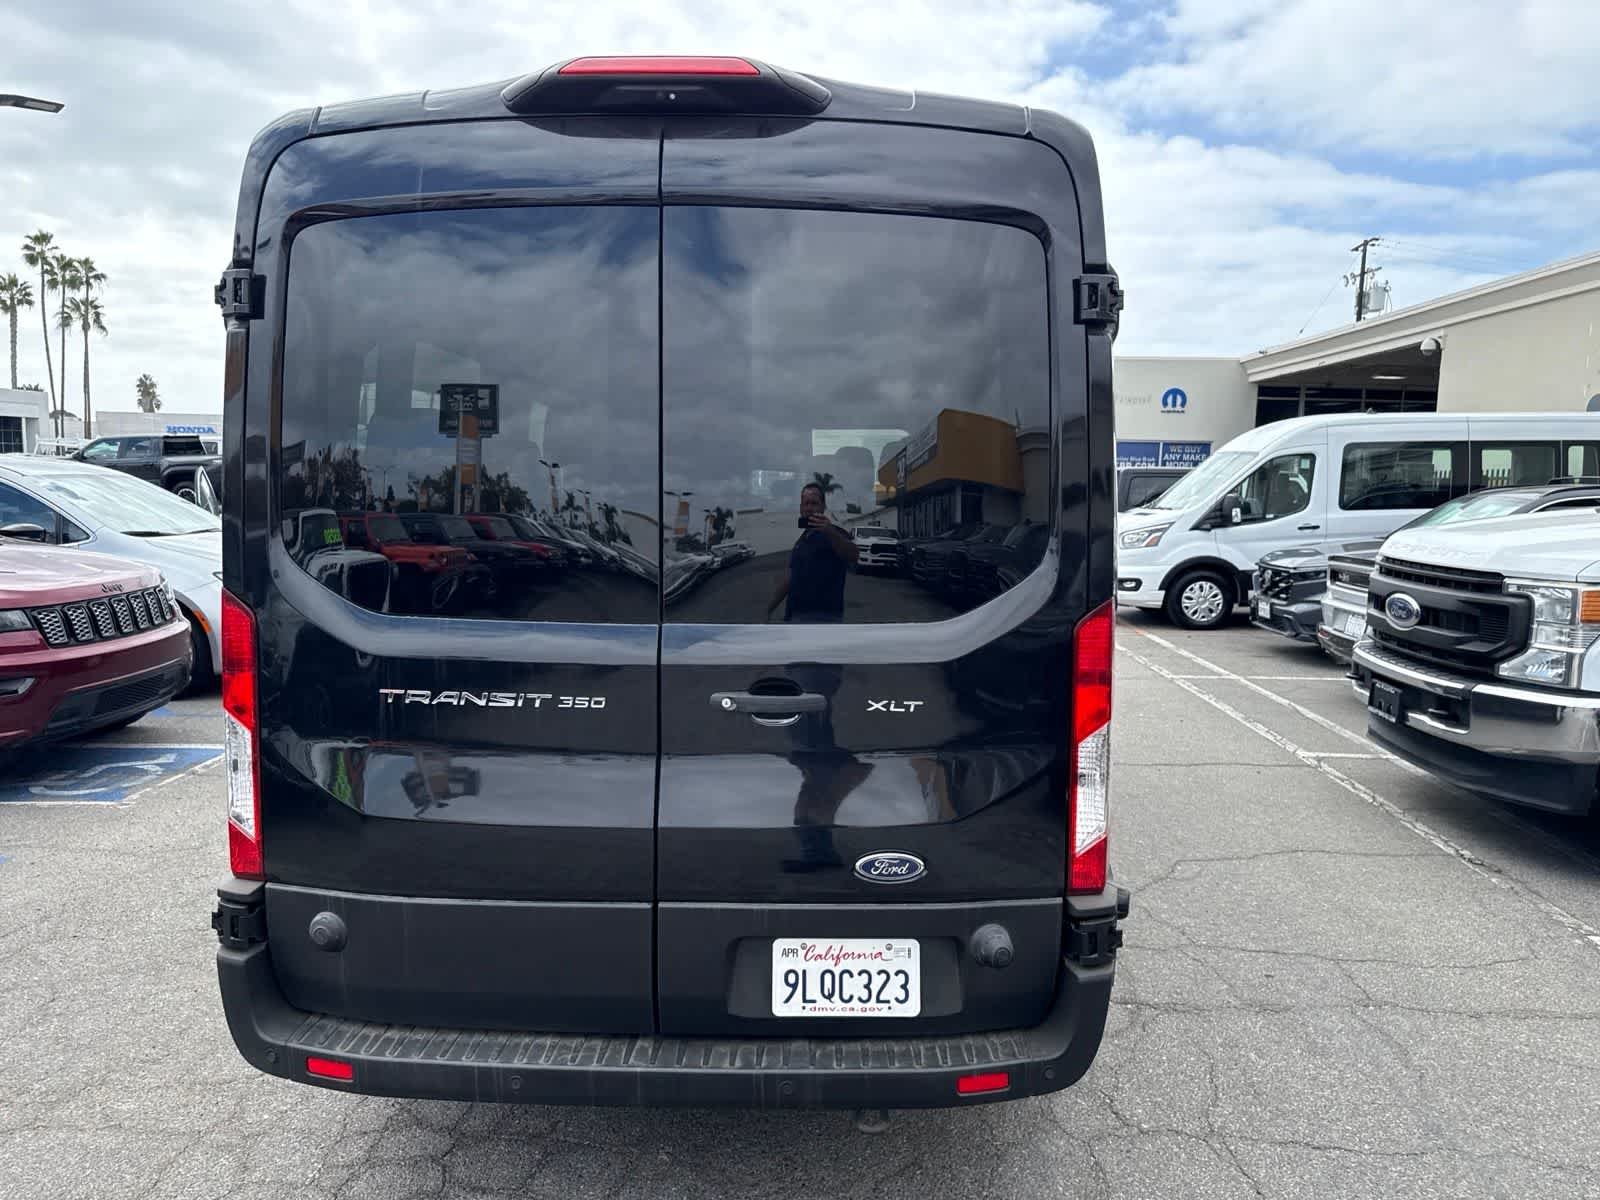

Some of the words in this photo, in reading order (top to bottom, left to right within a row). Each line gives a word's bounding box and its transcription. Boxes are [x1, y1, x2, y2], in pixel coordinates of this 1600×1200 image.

[165, 425, 216, 434] HONDA
[1163, 453, 1180, 461] ANY
[379, 688, 553, 708] TRANSIT
[558, 696, 606, 708] 350
[866, 699, 924, 712] XLT
[870, 858, 910, 875] Ford
[781, 947, 799, 958] APR
[803, 944, 893, 967] California
[783, 969, 910, 1004] 9LQC323
